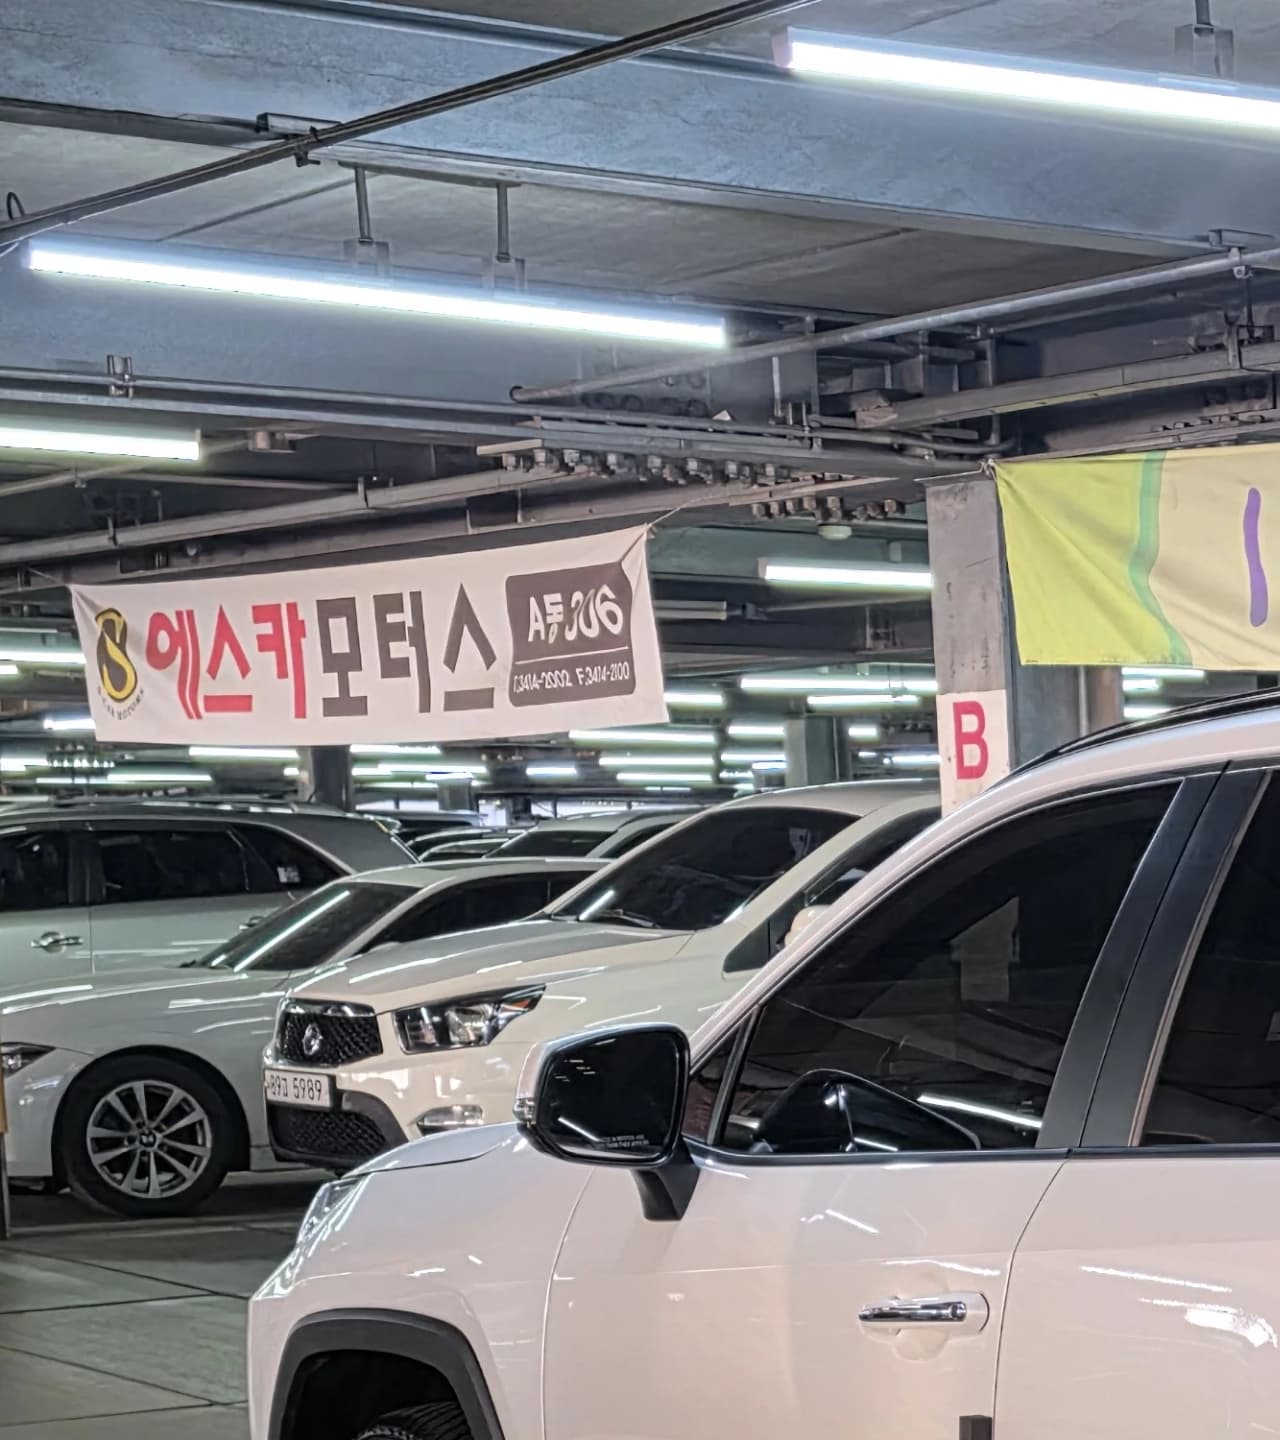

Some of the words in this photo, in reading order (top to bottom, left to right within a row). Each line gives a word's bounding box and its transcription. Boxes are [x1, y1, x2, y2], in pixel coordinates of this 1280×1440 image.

[145, 583, 496, 720] 에스카모터스
[953, 701, 989, 780] B
[293, 1077, 322, 1101] 5989
